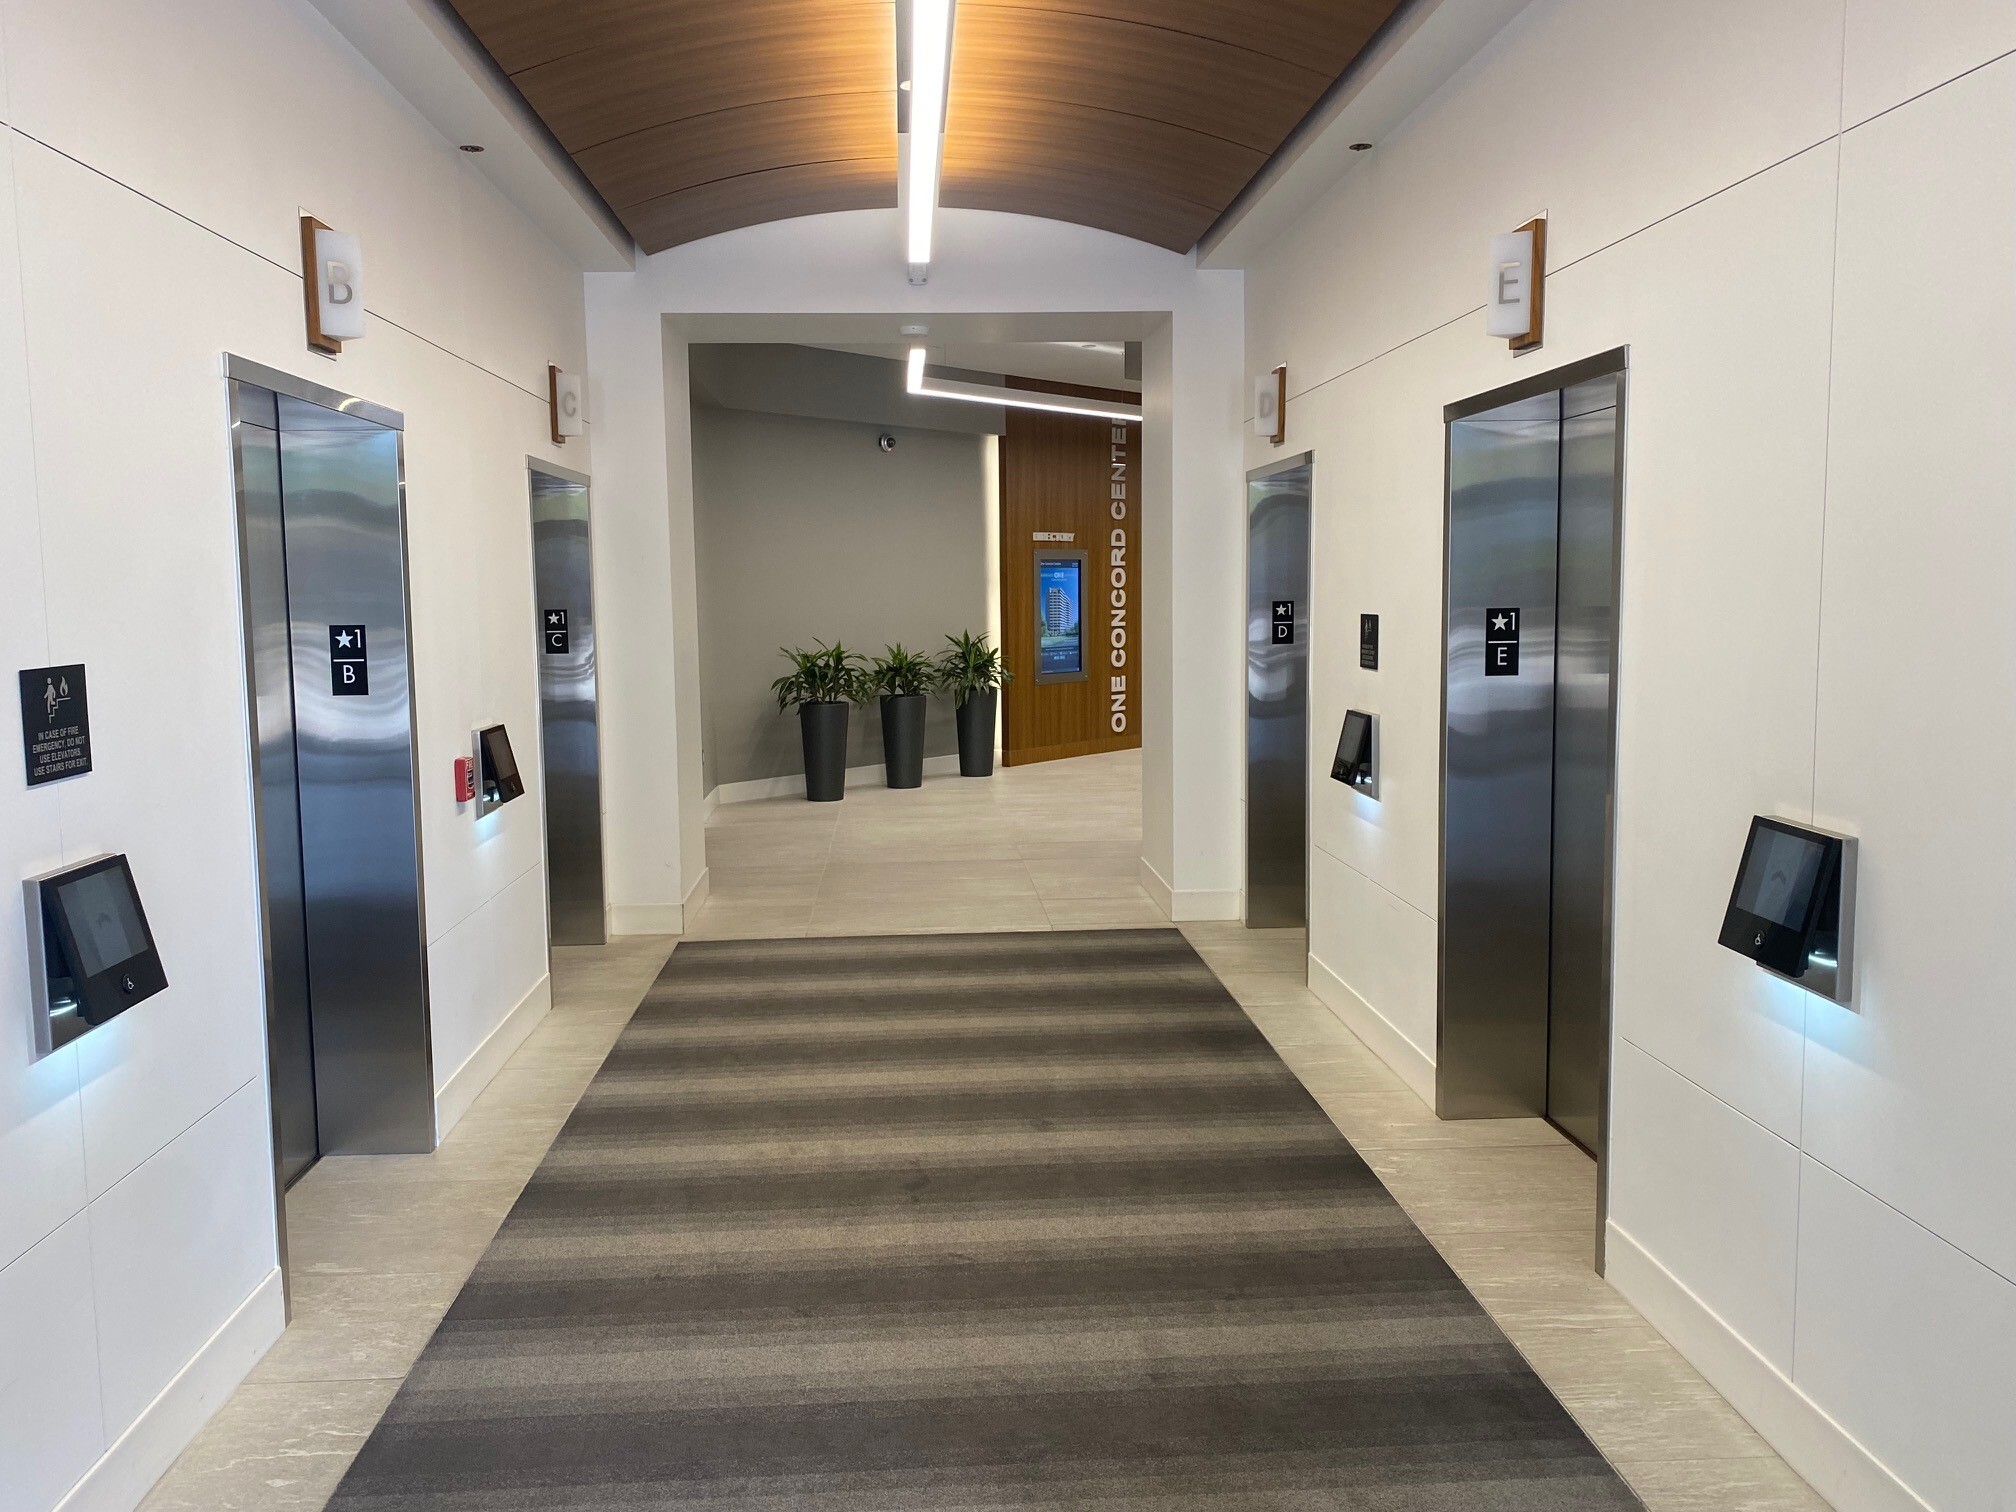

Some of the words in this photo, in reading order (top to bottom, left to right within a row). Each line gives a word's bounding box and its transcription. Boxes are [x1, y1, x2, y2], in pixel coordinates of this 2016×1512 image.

[326, 260, 353, 304] B
[1498, 261, 1520, 304] E
[561, 391, 576, 417] C
[1259, 391, 1274, 418] D
[1110, 528, 1126, 668] CONCORD
[551, 633, 563, 647] C
[1278, 625, 1288, 638] D
[1497, 647, 1508, 666] E
[343, 665, 356, 684] B
[1111, 675, 1126, 733] ONE
[38, 731, 44, 741] IN
[45, 729, 59, 740] CASE
[60, 728, 67, 737] OF
[68, 725, 79, 735] FIRE
[66, 737, 75, 747] DO
[75, 735, 86, 745] NOT
[33, 765, 46, 777] USE
[45, 762, 65, 774] STAIRS
[65, 759, 76, 769] FOR
[39, 753, 51, 764] USE
